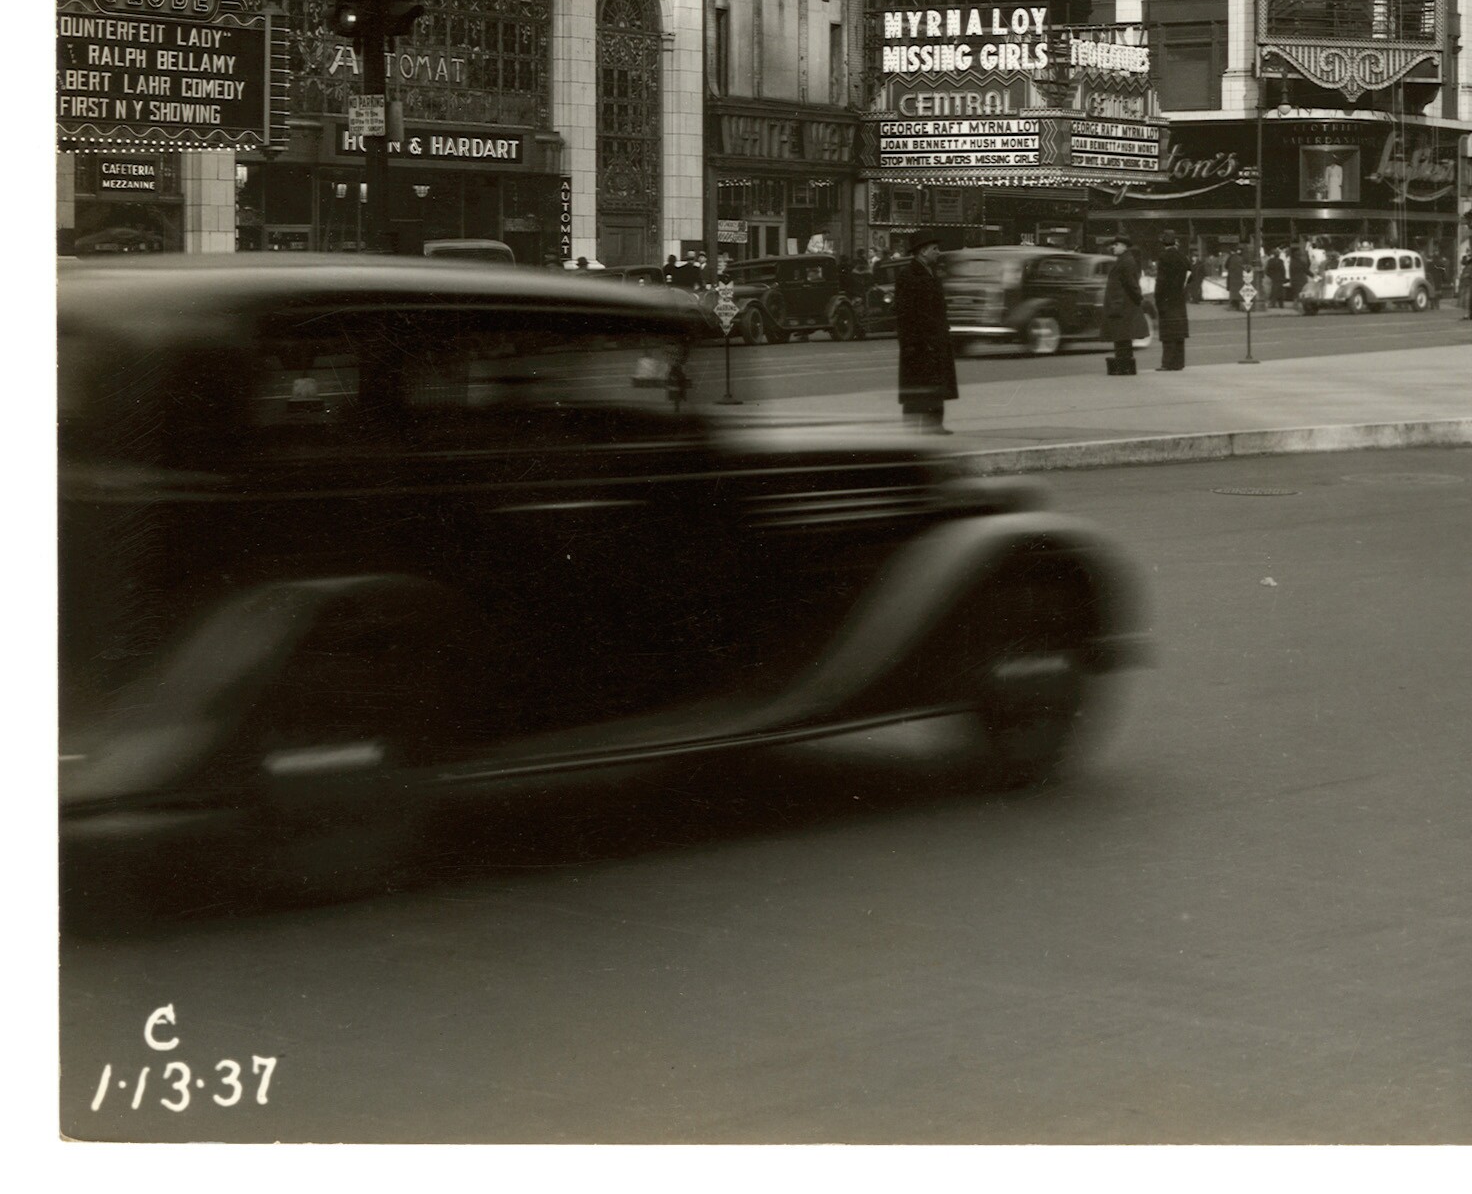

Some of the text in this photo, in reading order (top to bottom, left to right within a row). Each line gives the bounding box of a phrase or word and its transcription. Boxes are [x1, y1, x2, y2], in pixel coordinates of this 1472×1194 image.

[885, 7, 1047, 39] MYRNA LOY
[88, 44, 147, 68] RALPH
[157, 50, 236, 75] BELLAMY
[329, 45, 465, 83] ATOMAT
[883, 45, 972, 73] MISSING
[980, 43, 1048, 70] GIRLS
[66, 70, 112, 92] BERT
[124, 74, 170, 96] LAHR
[181, 78, 245, 100] COMEDY
[60, 97, 221, 125] FIRST N Y SHOWING
[900, 89, 1018, 118] CENTRAL
[882, 119, 1038, 135] GEORGE RAFT MYRNA LOY
[410, 136, 519, 159] & HARDART
[882, 138, 1036, 150] JOAN BENNETT HUSH MONEY
[102, 162, 155, 176] CAFETERIA
[881, 153, 1039, 166] STOP WHITE SLAVERS MISSING GIRLS
[102, 179, 156, 190] MEZZANINE
[561, 181, 570, 254] AUTOMAT
